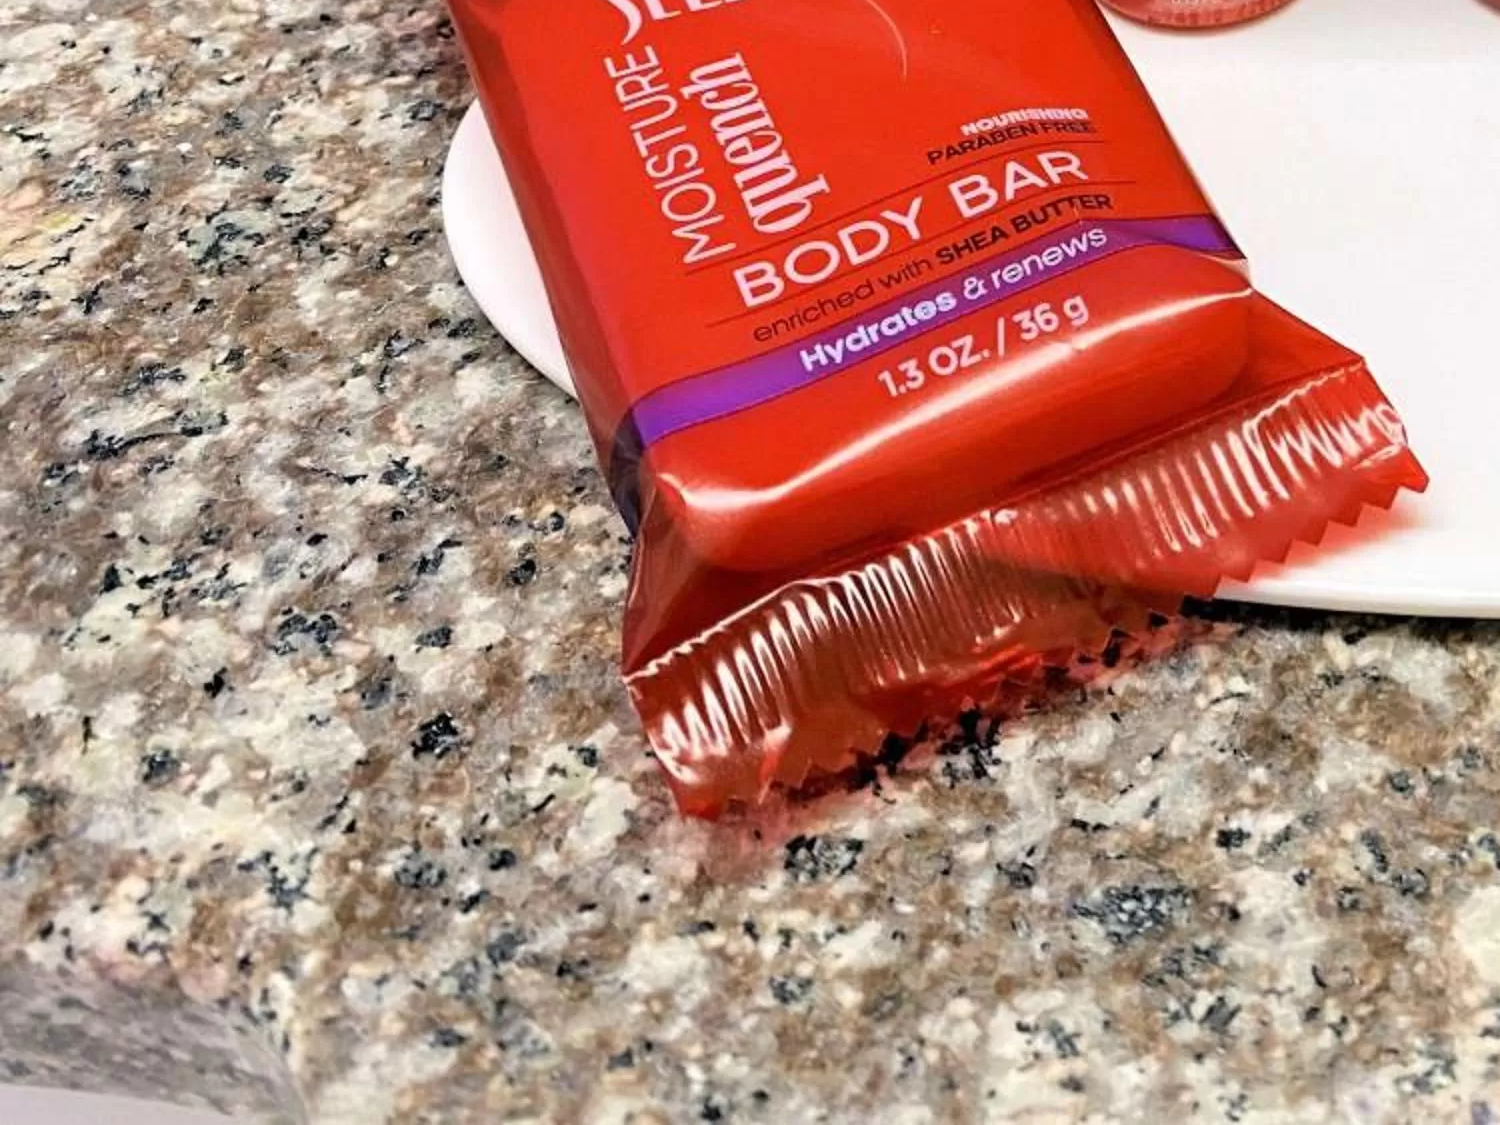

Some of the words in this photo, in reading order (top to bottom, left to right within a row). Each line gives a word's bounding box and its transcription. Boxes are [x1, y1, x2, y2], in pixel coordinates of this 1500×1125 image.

[604, 45, 736, 263] MOISTURE
[679, 52, 830, 233] quench
[927, 122, 1039, 165] PARABEN
[1040, 120, 1096, 137] FREE
[960, 106, 1090, 136] NOURISHING
[734, 196, 924, 308] BODY
[948, 150, 1088, 219] BAR
[753, 278, 875, 343] enriched
[878, 256, 934, 290] with
[936, 228, 1009, 266] SHEA
[1011, 193, 1113, 234] BUTTER
[799, 289, 957, 372] Hydrates
[963, 275, 989, 302] &
[992, 226, 1108, 290] renews
[877, 362, 925, 398] 1.3
[928, 333, 989, 376] OZ.
[996, 317, 1006, 357] /
[1012, 302, 1060, 342] 36
[1063, 295, 1090, 326] g
